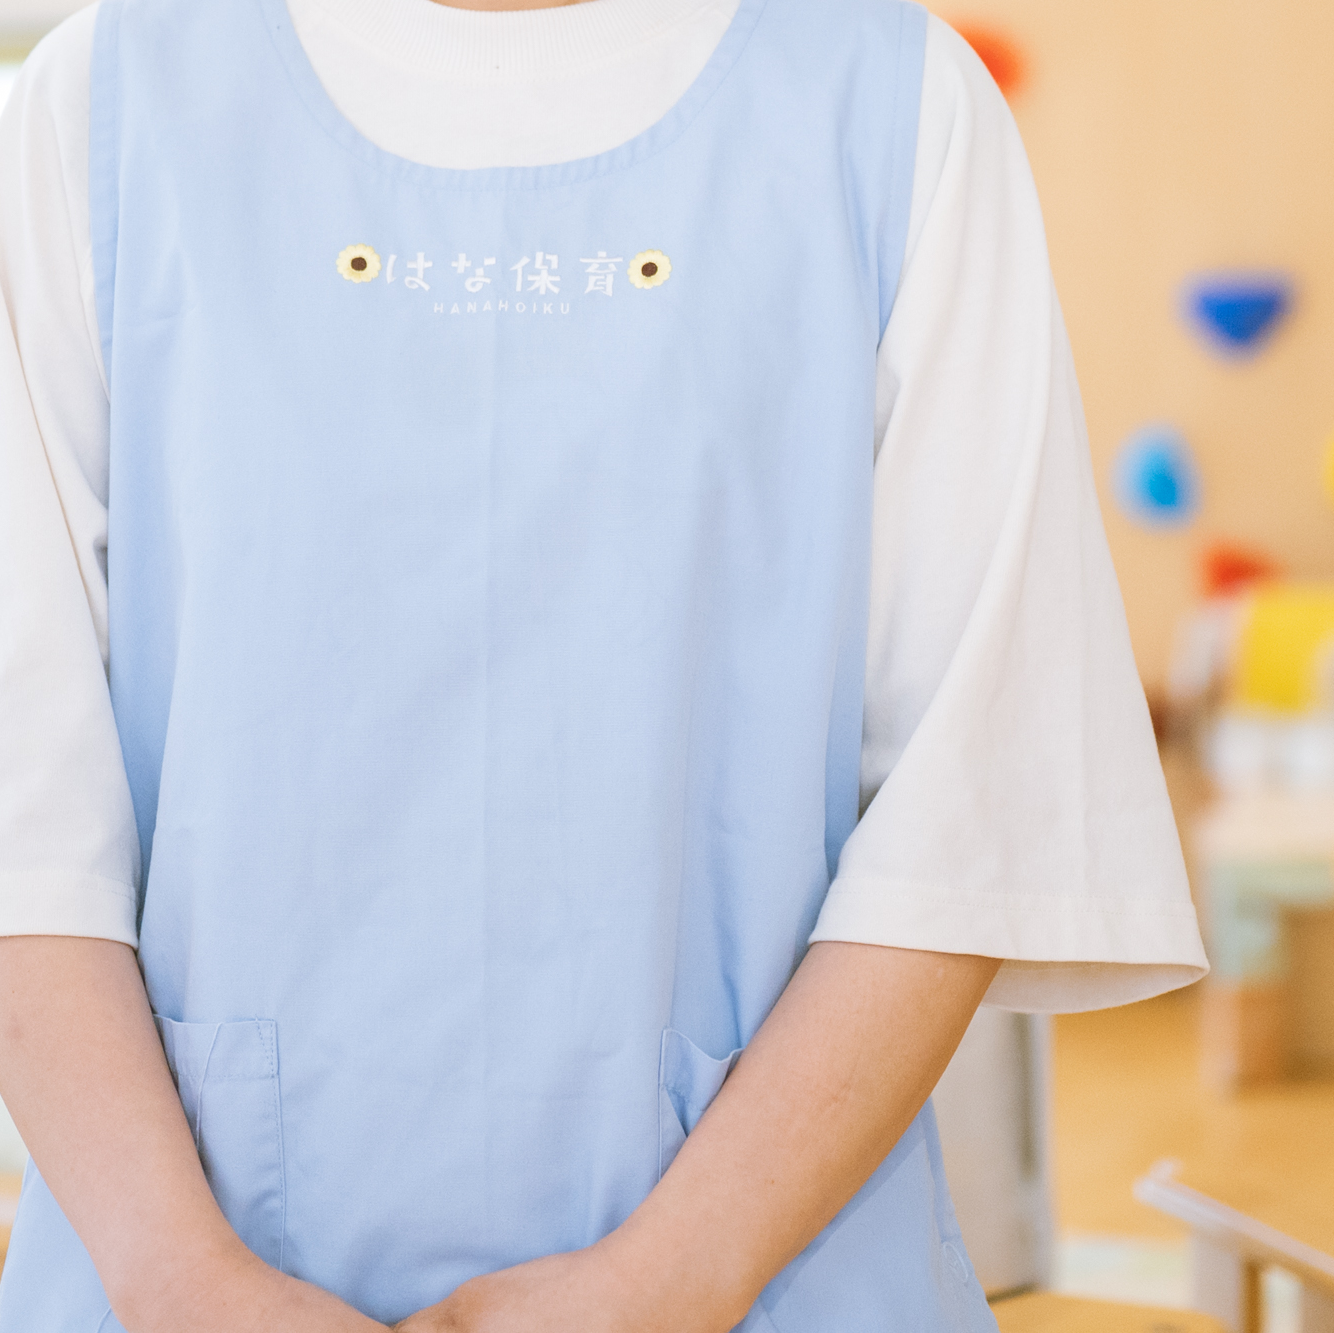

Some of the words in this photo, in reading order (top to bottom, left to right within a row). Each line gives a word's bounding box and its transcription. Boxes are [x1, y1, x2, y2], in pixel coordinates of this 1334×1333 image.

[386, 251, 623, 297] はな保育
[433, 300, 571, 315] HANAHOIKU
